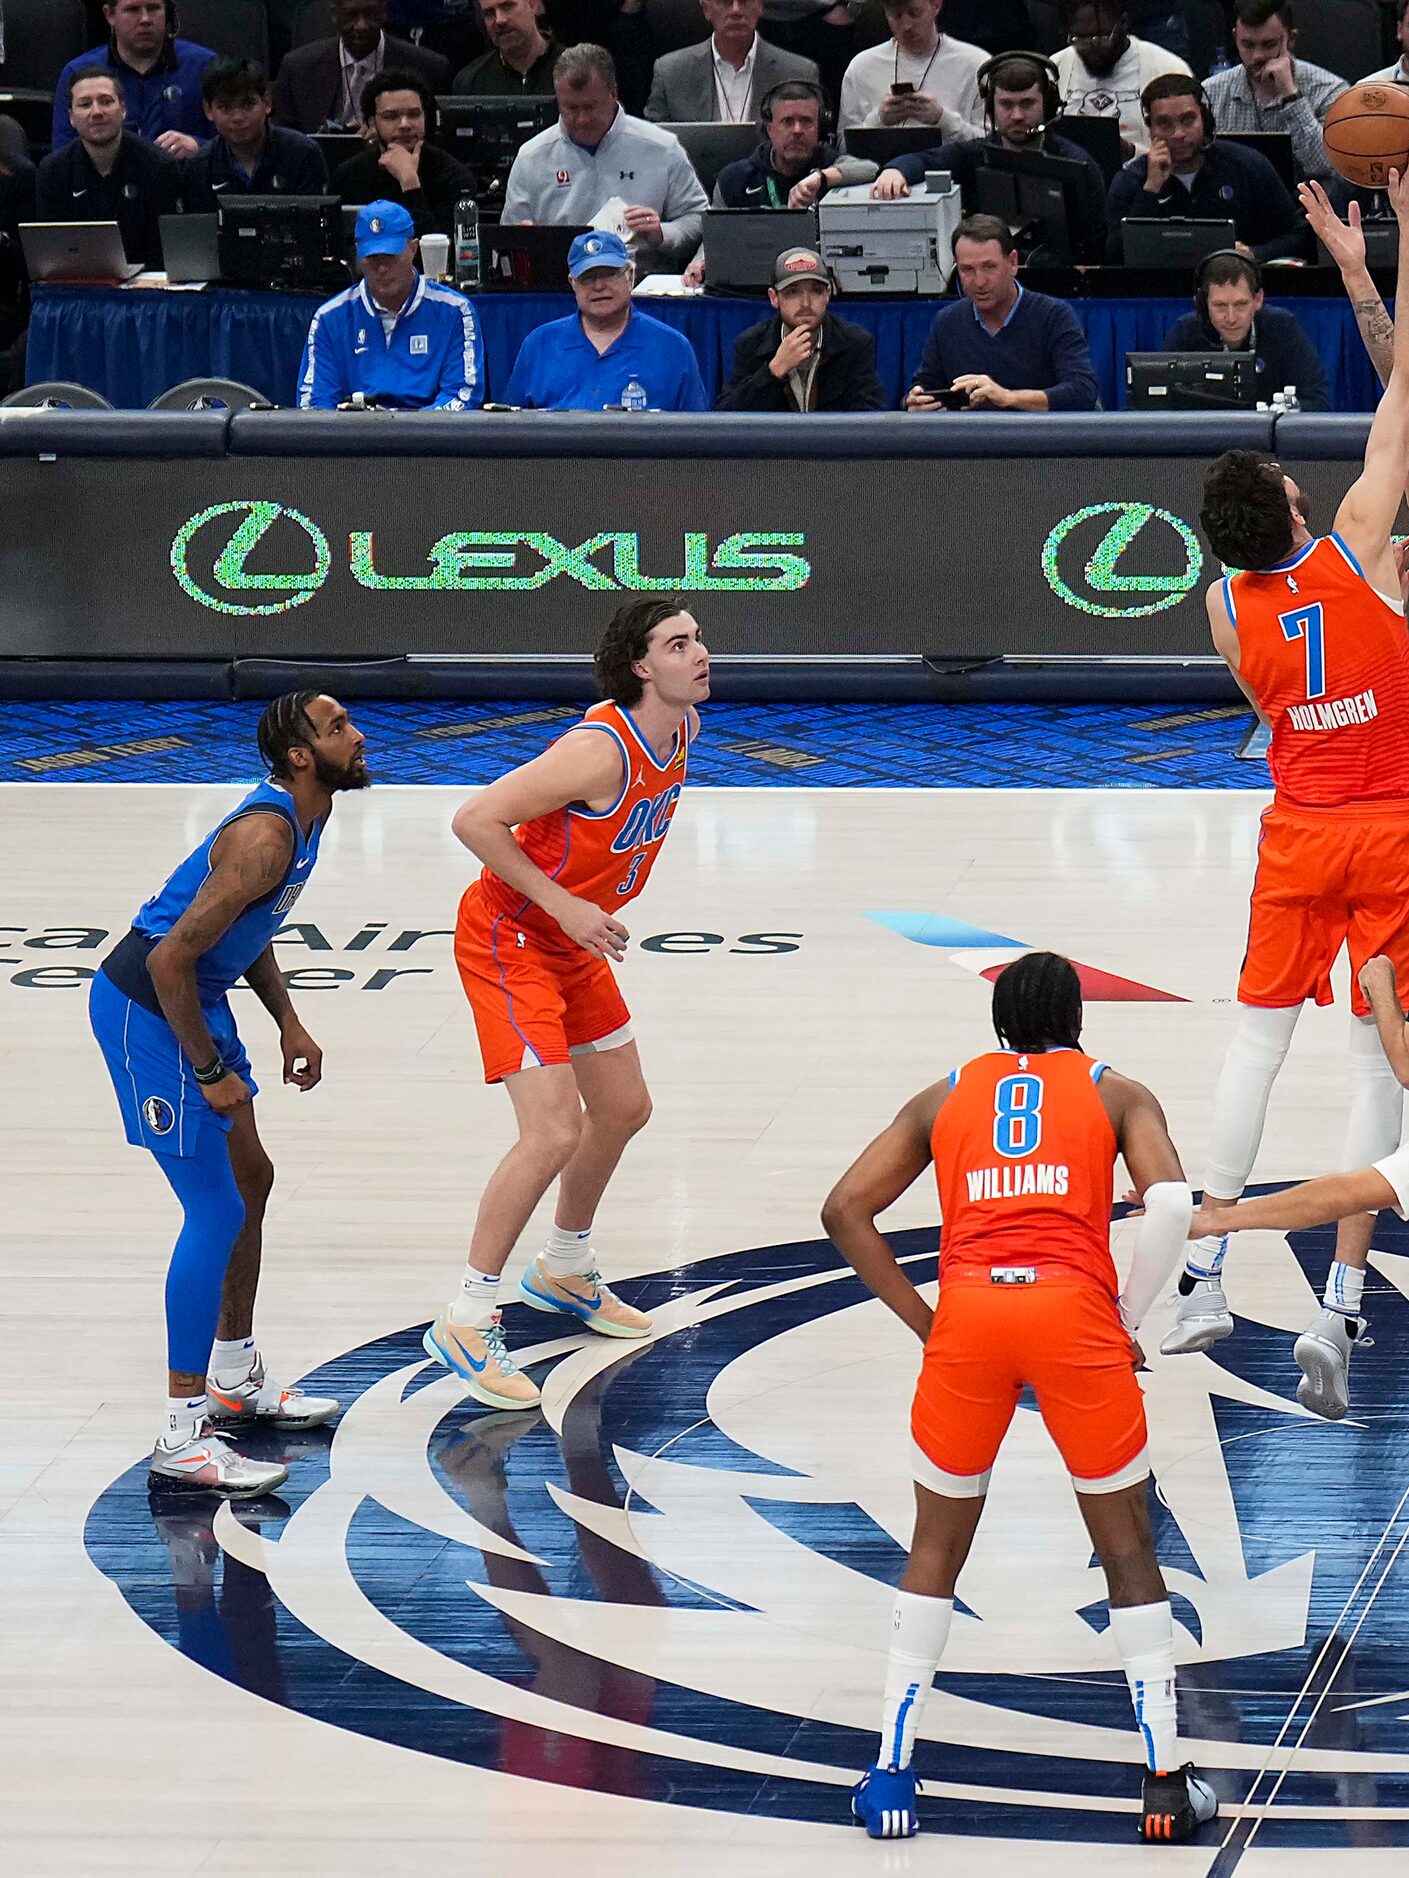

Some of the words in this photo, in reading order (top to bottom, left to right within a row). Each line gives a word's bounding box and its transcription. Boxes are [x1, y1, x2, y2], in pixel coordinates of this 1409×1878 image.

[349, 531, 812, 592] LEXUS
[1277, 601, 1326, 700] 7
[1286, 688, 1378, 731] HOLMGREN
[13, 750, 110, 772] JASON
[96, 736, 192, 757] TERRY
[610, 782, 681, 854] OKC
[616, 851, 648, 895] 3
[993, 1073, 1044, 1158] 8
[966, 1164, 1069, 1202] WILLIAMS
